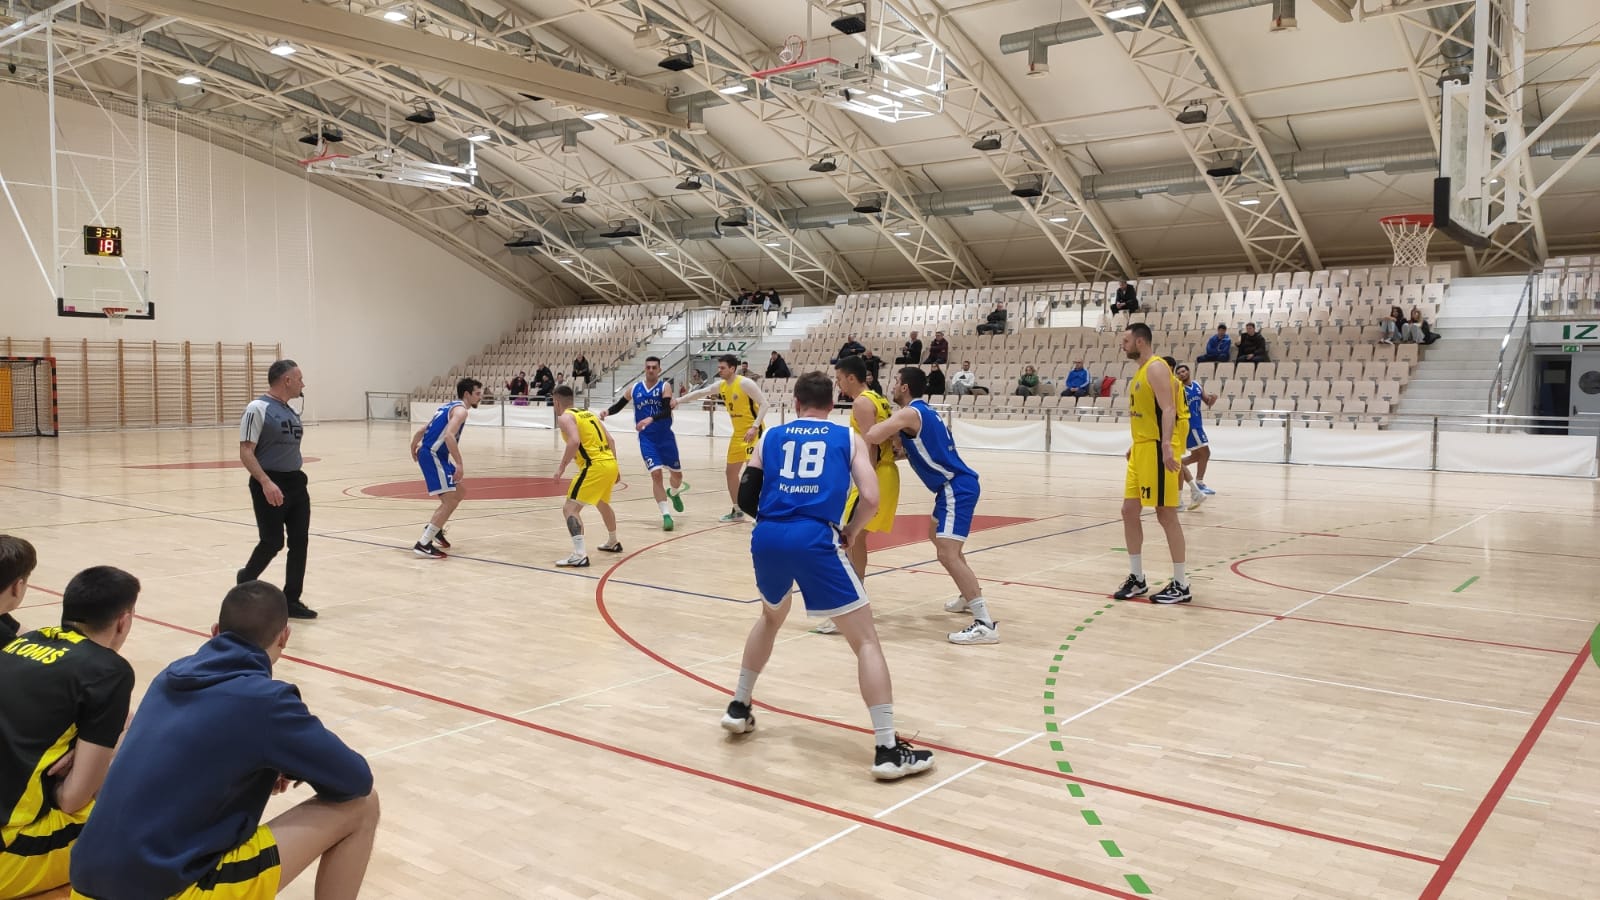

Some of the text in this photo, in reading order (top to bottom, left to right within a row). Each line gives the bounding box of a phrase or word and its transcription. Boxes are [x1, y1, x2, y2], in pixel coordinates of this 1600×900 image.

[95, 227, 119, 238] 3:34
[100, 239, 114, 254] 18
[1562, 324, 1599, 340] IZ
[702, 341, 747, 352] IZLAZ
[779, 440, 827, 479] 18
